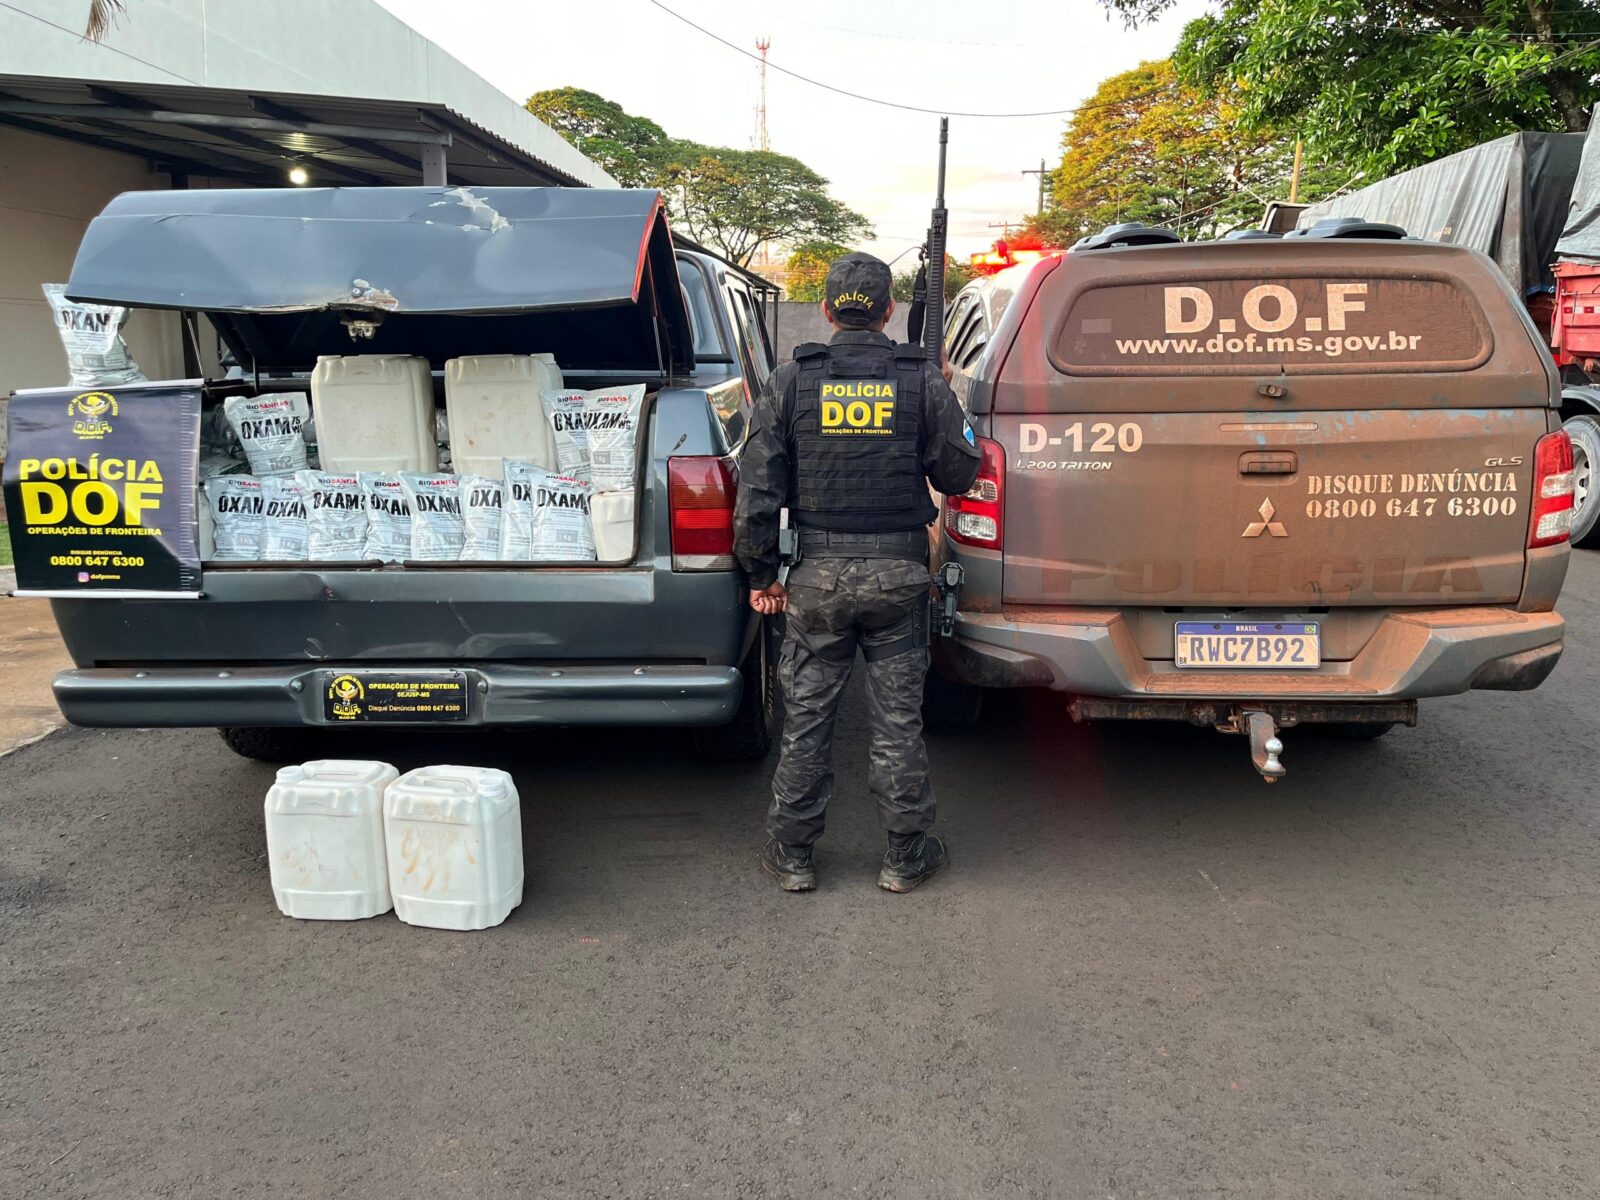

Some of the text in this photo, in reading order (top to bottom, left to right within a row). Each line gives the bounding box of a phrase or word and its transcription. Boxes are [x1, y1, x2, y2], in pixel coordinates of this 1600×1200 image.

[833, 291, 874, 309] POLÍCIA
[1164, 283, 1367, 333] D.O.F
[1115, 331, 1422, 357] www.dof.ms.gov.br
[822, 382, 893, 397] POLÍCIA
[821, 401, 894, 427] DOF
[241, 417, 291, 439] OXAM
[1019, 422, 1143, 453] D-120
[20, 453, 163, 481] POLÍCIA
[1017, 460, 1112, 471] L200 TRITON
[1484, 456, 1523, 467] GLS
[1307, 468, 1517, 496] DISQUE DENÚNCIA
[20, 481, 163, 526] DOF
[1306, 497, 1517, 518] 0800 647 6300
[27, 525, 162, 537] OPERAÇÕES DE FRONTEIRA
[50, 556, 144, 567] 0800 647 6300
[1190, 637, 1305, 662] RWC7B92
